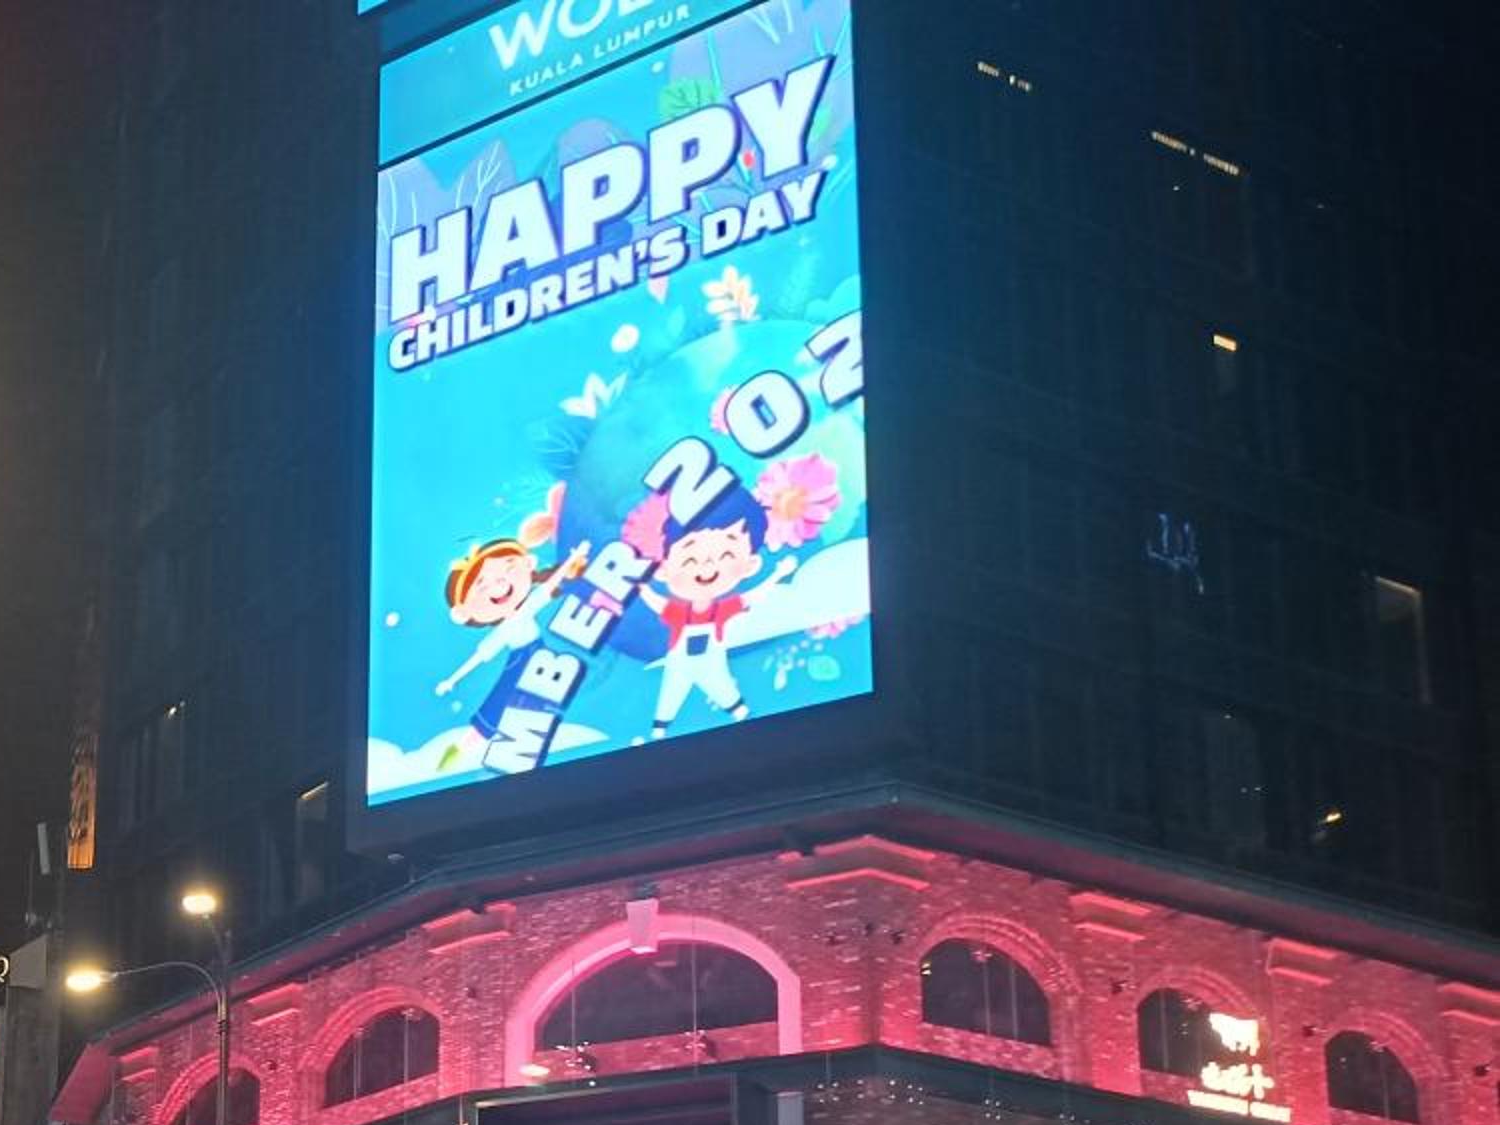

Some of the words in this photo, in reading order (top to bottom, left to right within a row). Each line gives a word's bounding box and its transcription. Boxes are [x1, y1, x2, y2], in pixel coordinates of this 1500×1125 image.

[509, 53, 584, 96] KUALA
[594, 3, 691, 59] LUMPUR
[388, 225, 689, 372] CHILDREN'S
[701, 171, 827, 257] DAY
[389, 53, 837, 323] HAPPY
